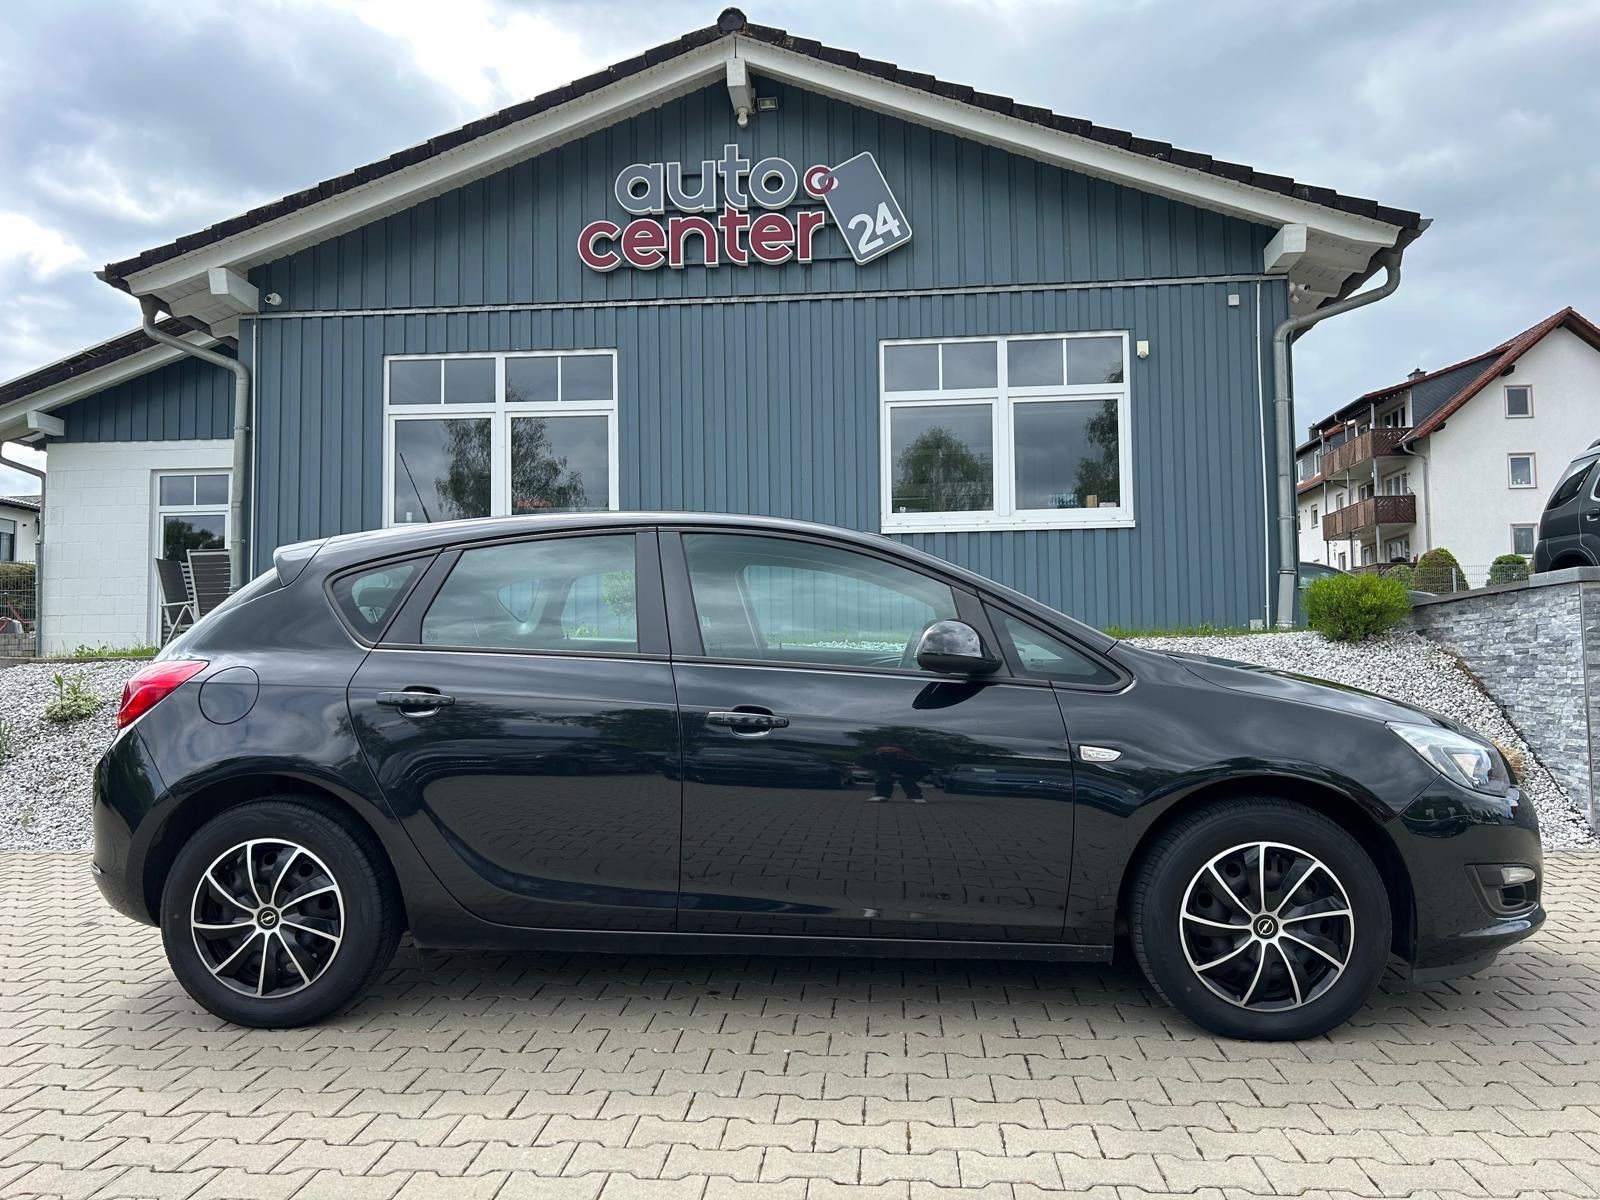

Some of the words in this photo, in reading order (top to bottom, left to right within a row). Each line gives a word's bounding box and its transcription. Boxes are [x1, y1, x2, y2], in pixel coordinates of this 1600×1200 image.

[615, 144, 798, 214] auto
[577, 203, 824, 271] center
[847, 201, 901, 255] 24
